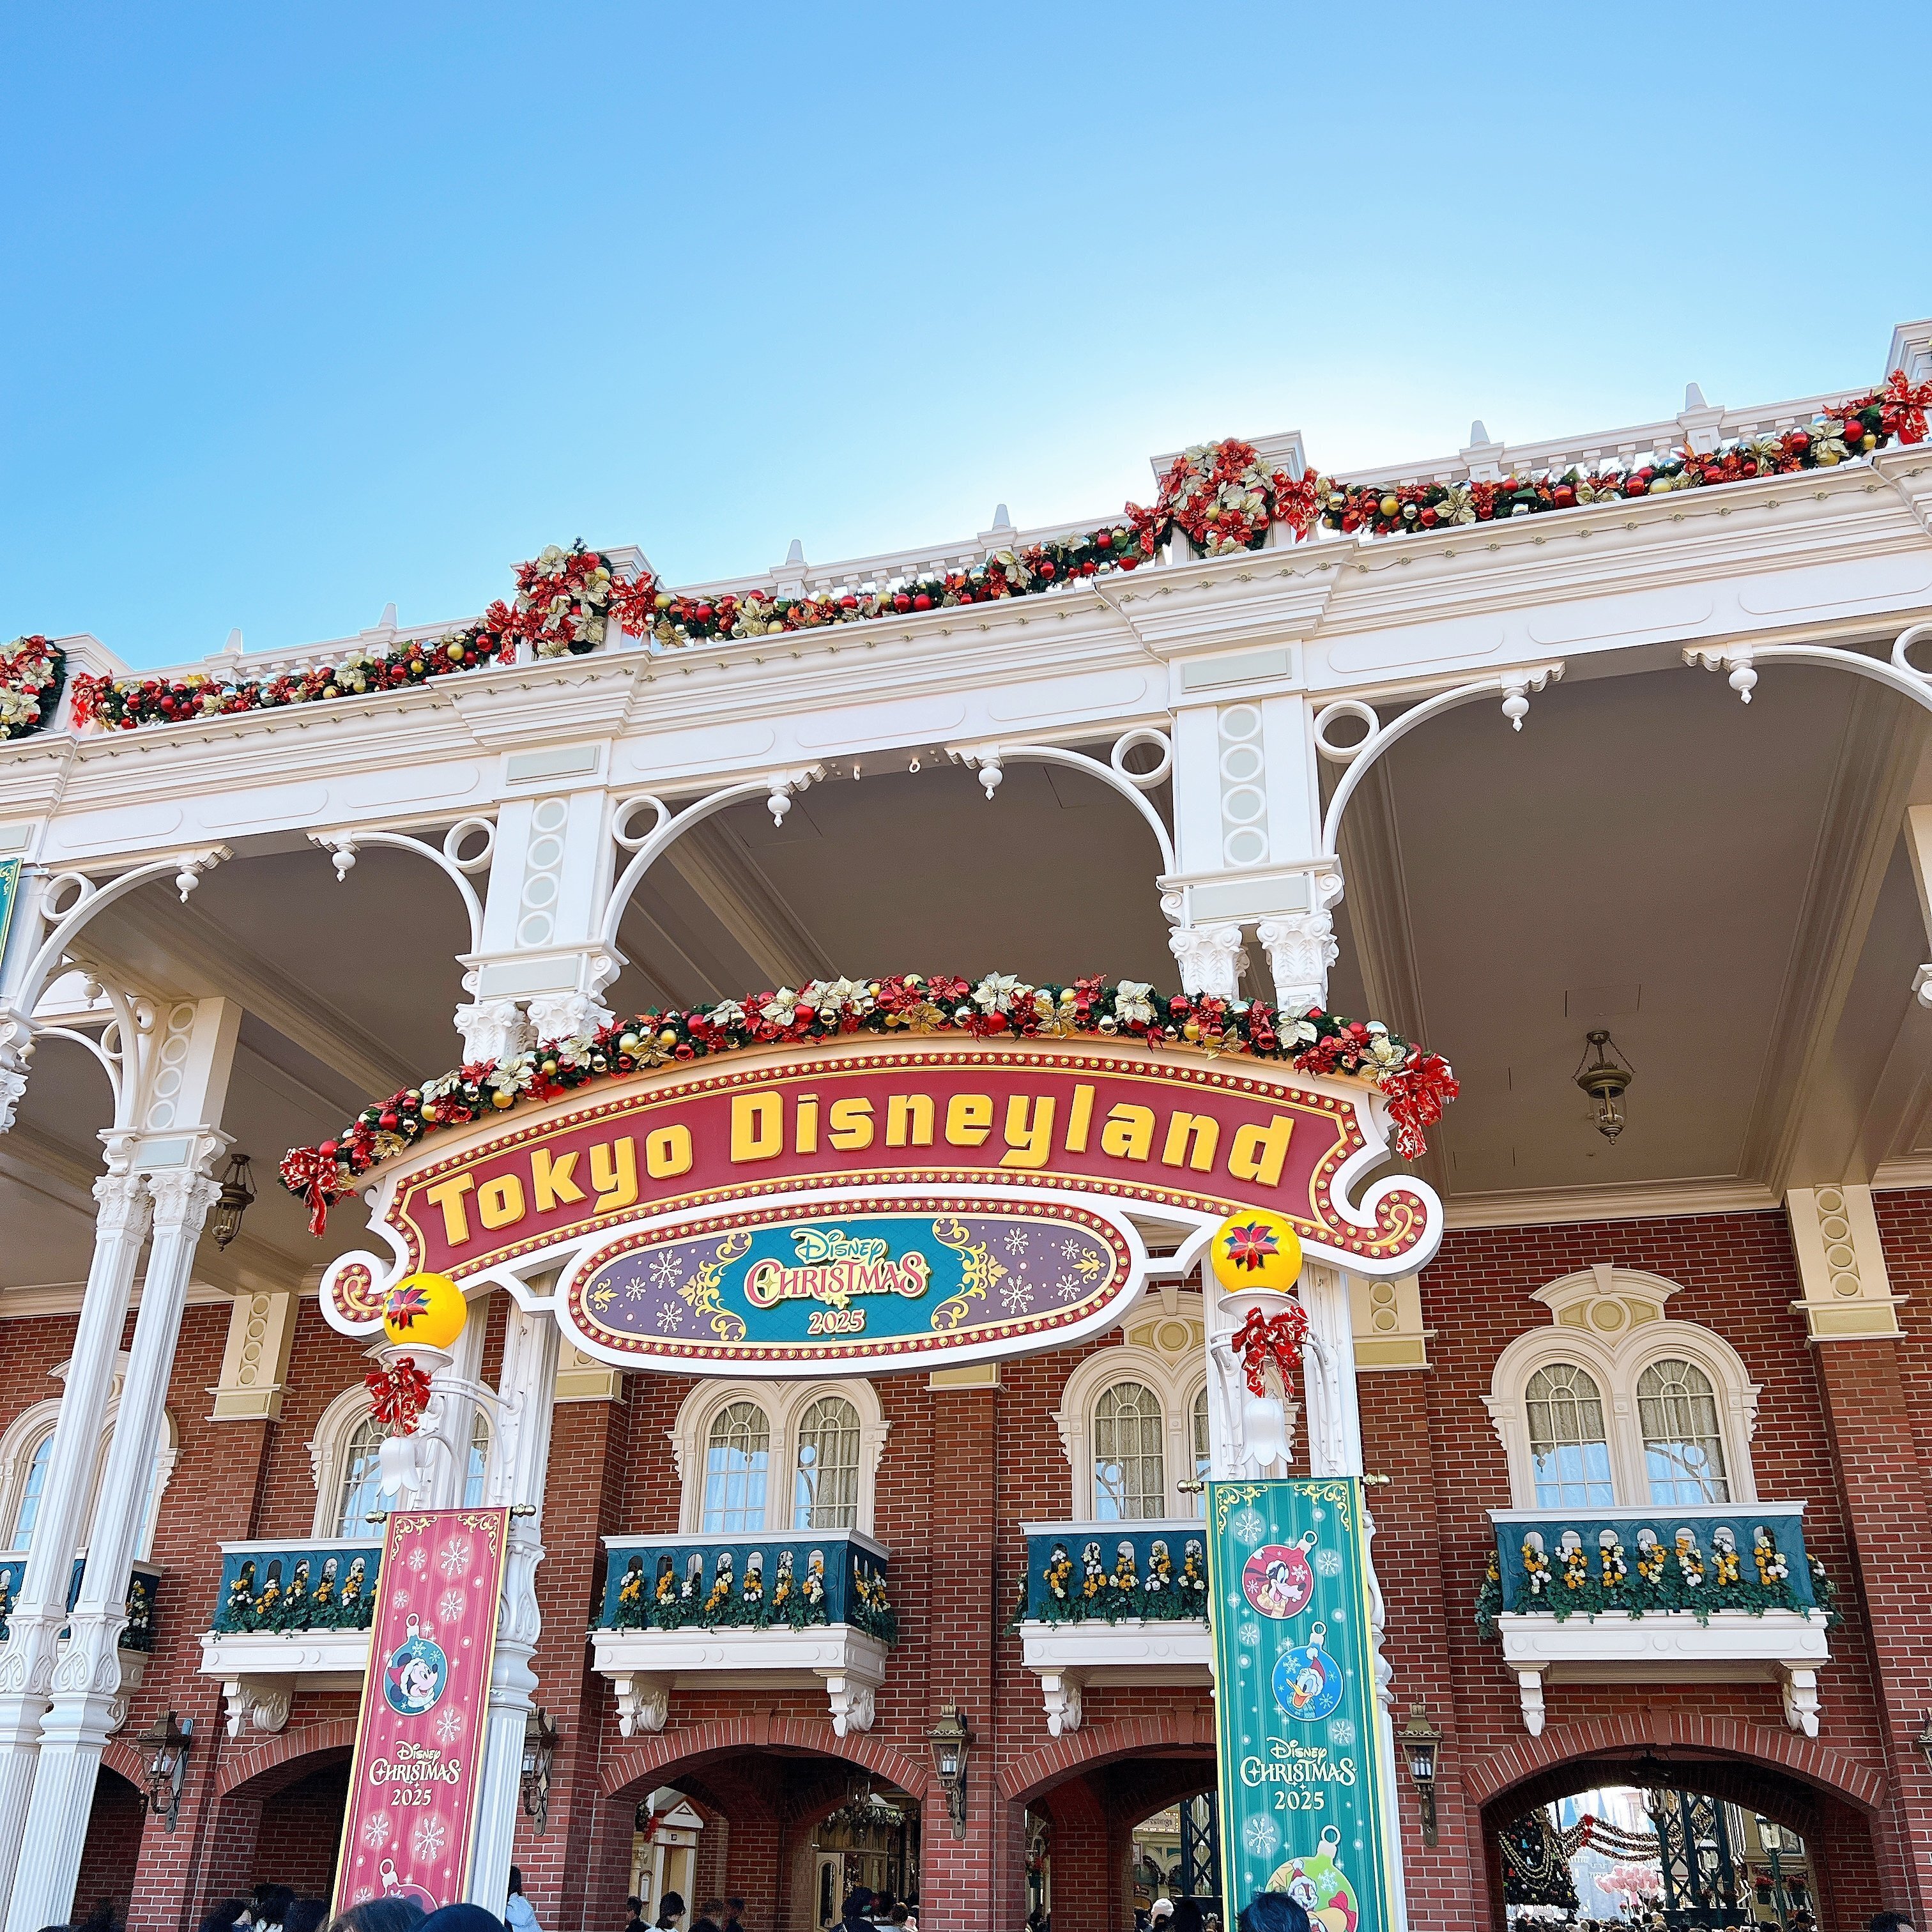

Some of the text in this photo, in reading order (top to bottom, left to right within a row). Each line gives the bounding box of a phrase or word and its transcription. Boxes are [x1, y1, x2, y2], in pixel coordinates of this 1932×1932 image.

[426, 1084, 1296, 1247] Tokyo Disneyland
[745, 1253, 928, 1307] CHRISTMAS
[808, 1309, 865, 1334] 2025
[369, 1758, 461, 1786] CHRISTMAS
[1239, 1756, 1356, 1788] CHRISTMAS
[390, 1788, 433, 1806] 2025
[1274, 1790, 1325, 1811] 2025
